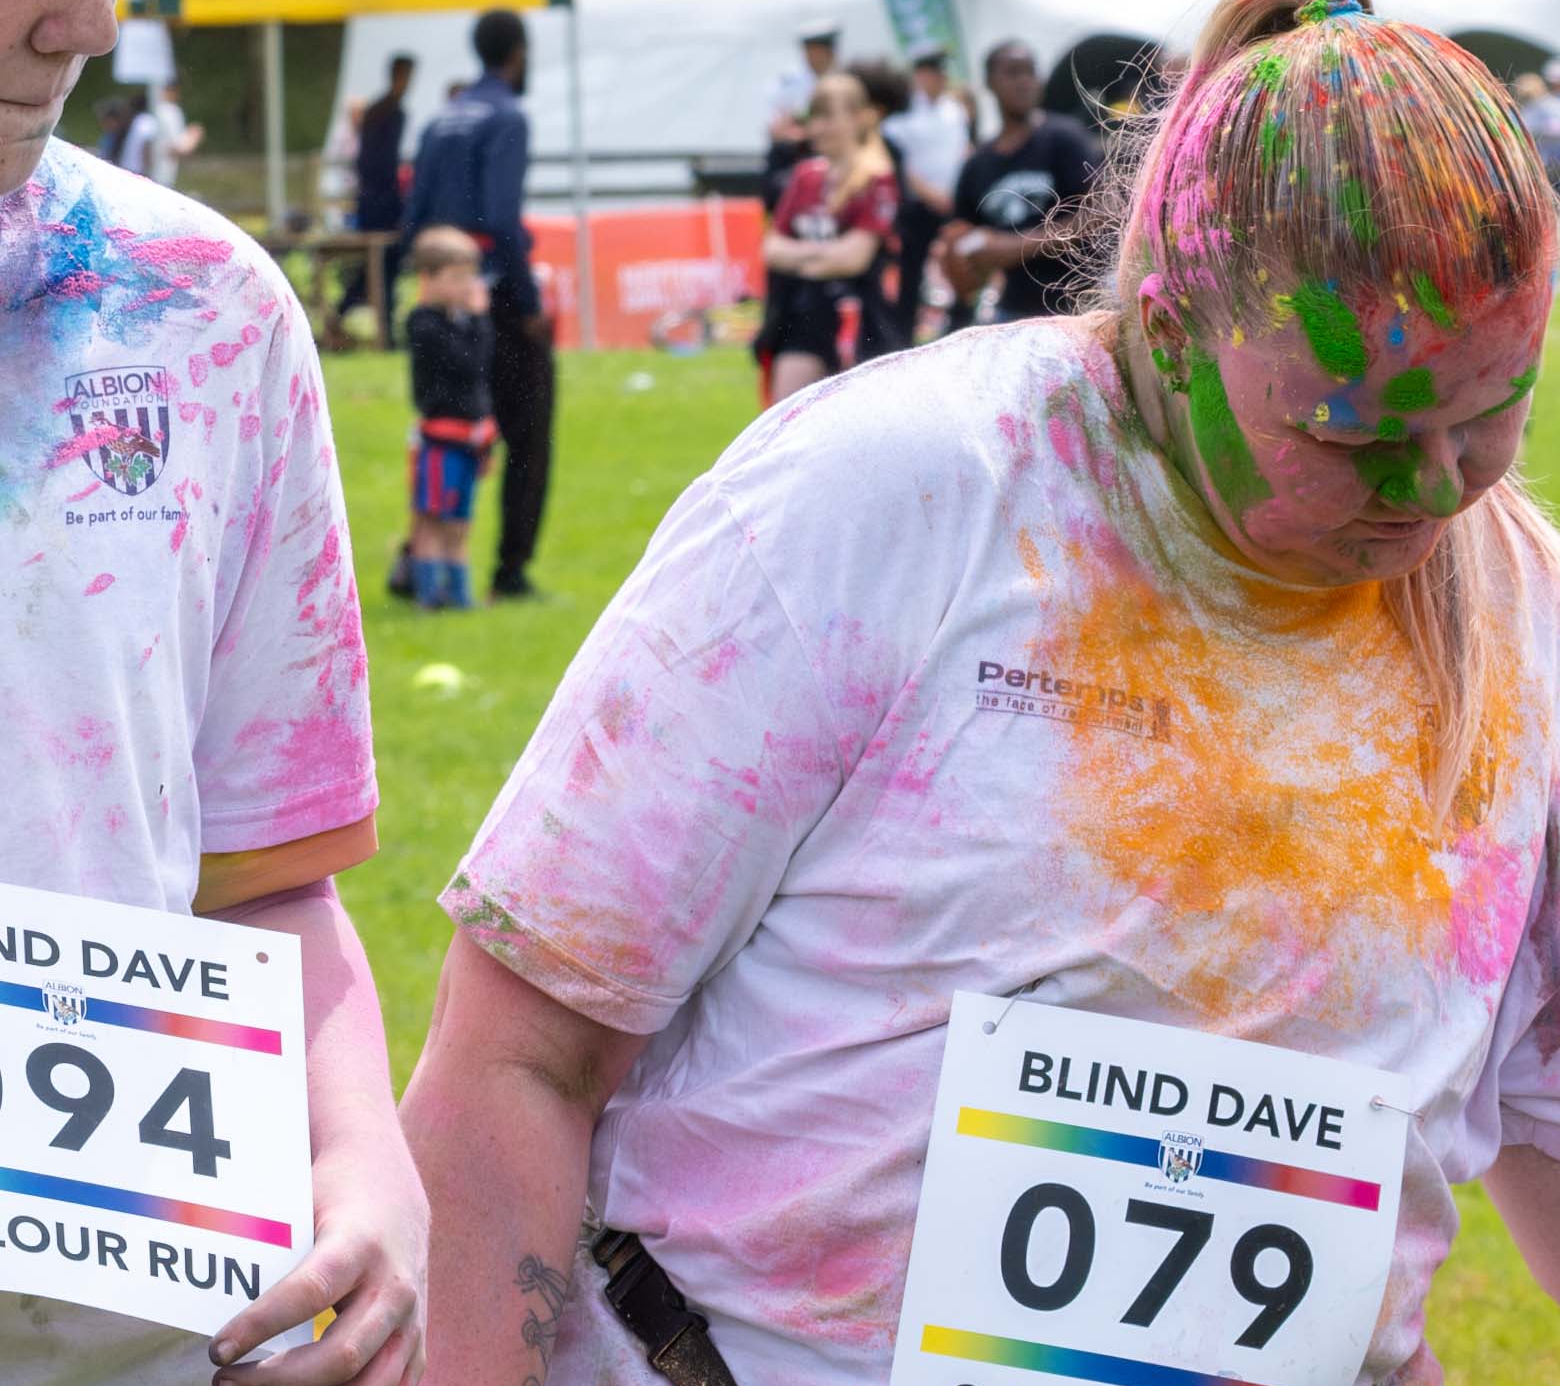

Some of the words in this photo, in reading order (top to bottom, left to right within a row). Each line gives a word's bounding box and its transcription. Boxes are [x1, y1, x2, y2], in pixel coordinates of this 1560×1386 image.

[73, 372, 161, 400] ALBION
[66, 511, 83, 525] Be
[89, 509, 116, 526] part
[121, 506, 134, 521] of
[137, 509, 157, 521] our
[1007, 696, 1034, 712] face
[81, 939, 231, 1001] DAVE
[1018, 1050, 1189, 1116] BLIND
[1206, 1083, 1345, 1151] DAVE
[1164, 1132, 1202, 1147] ALBION
[148, 1240, 260, 1302] RUN
[999, 1182, 1314, 1351] 079
